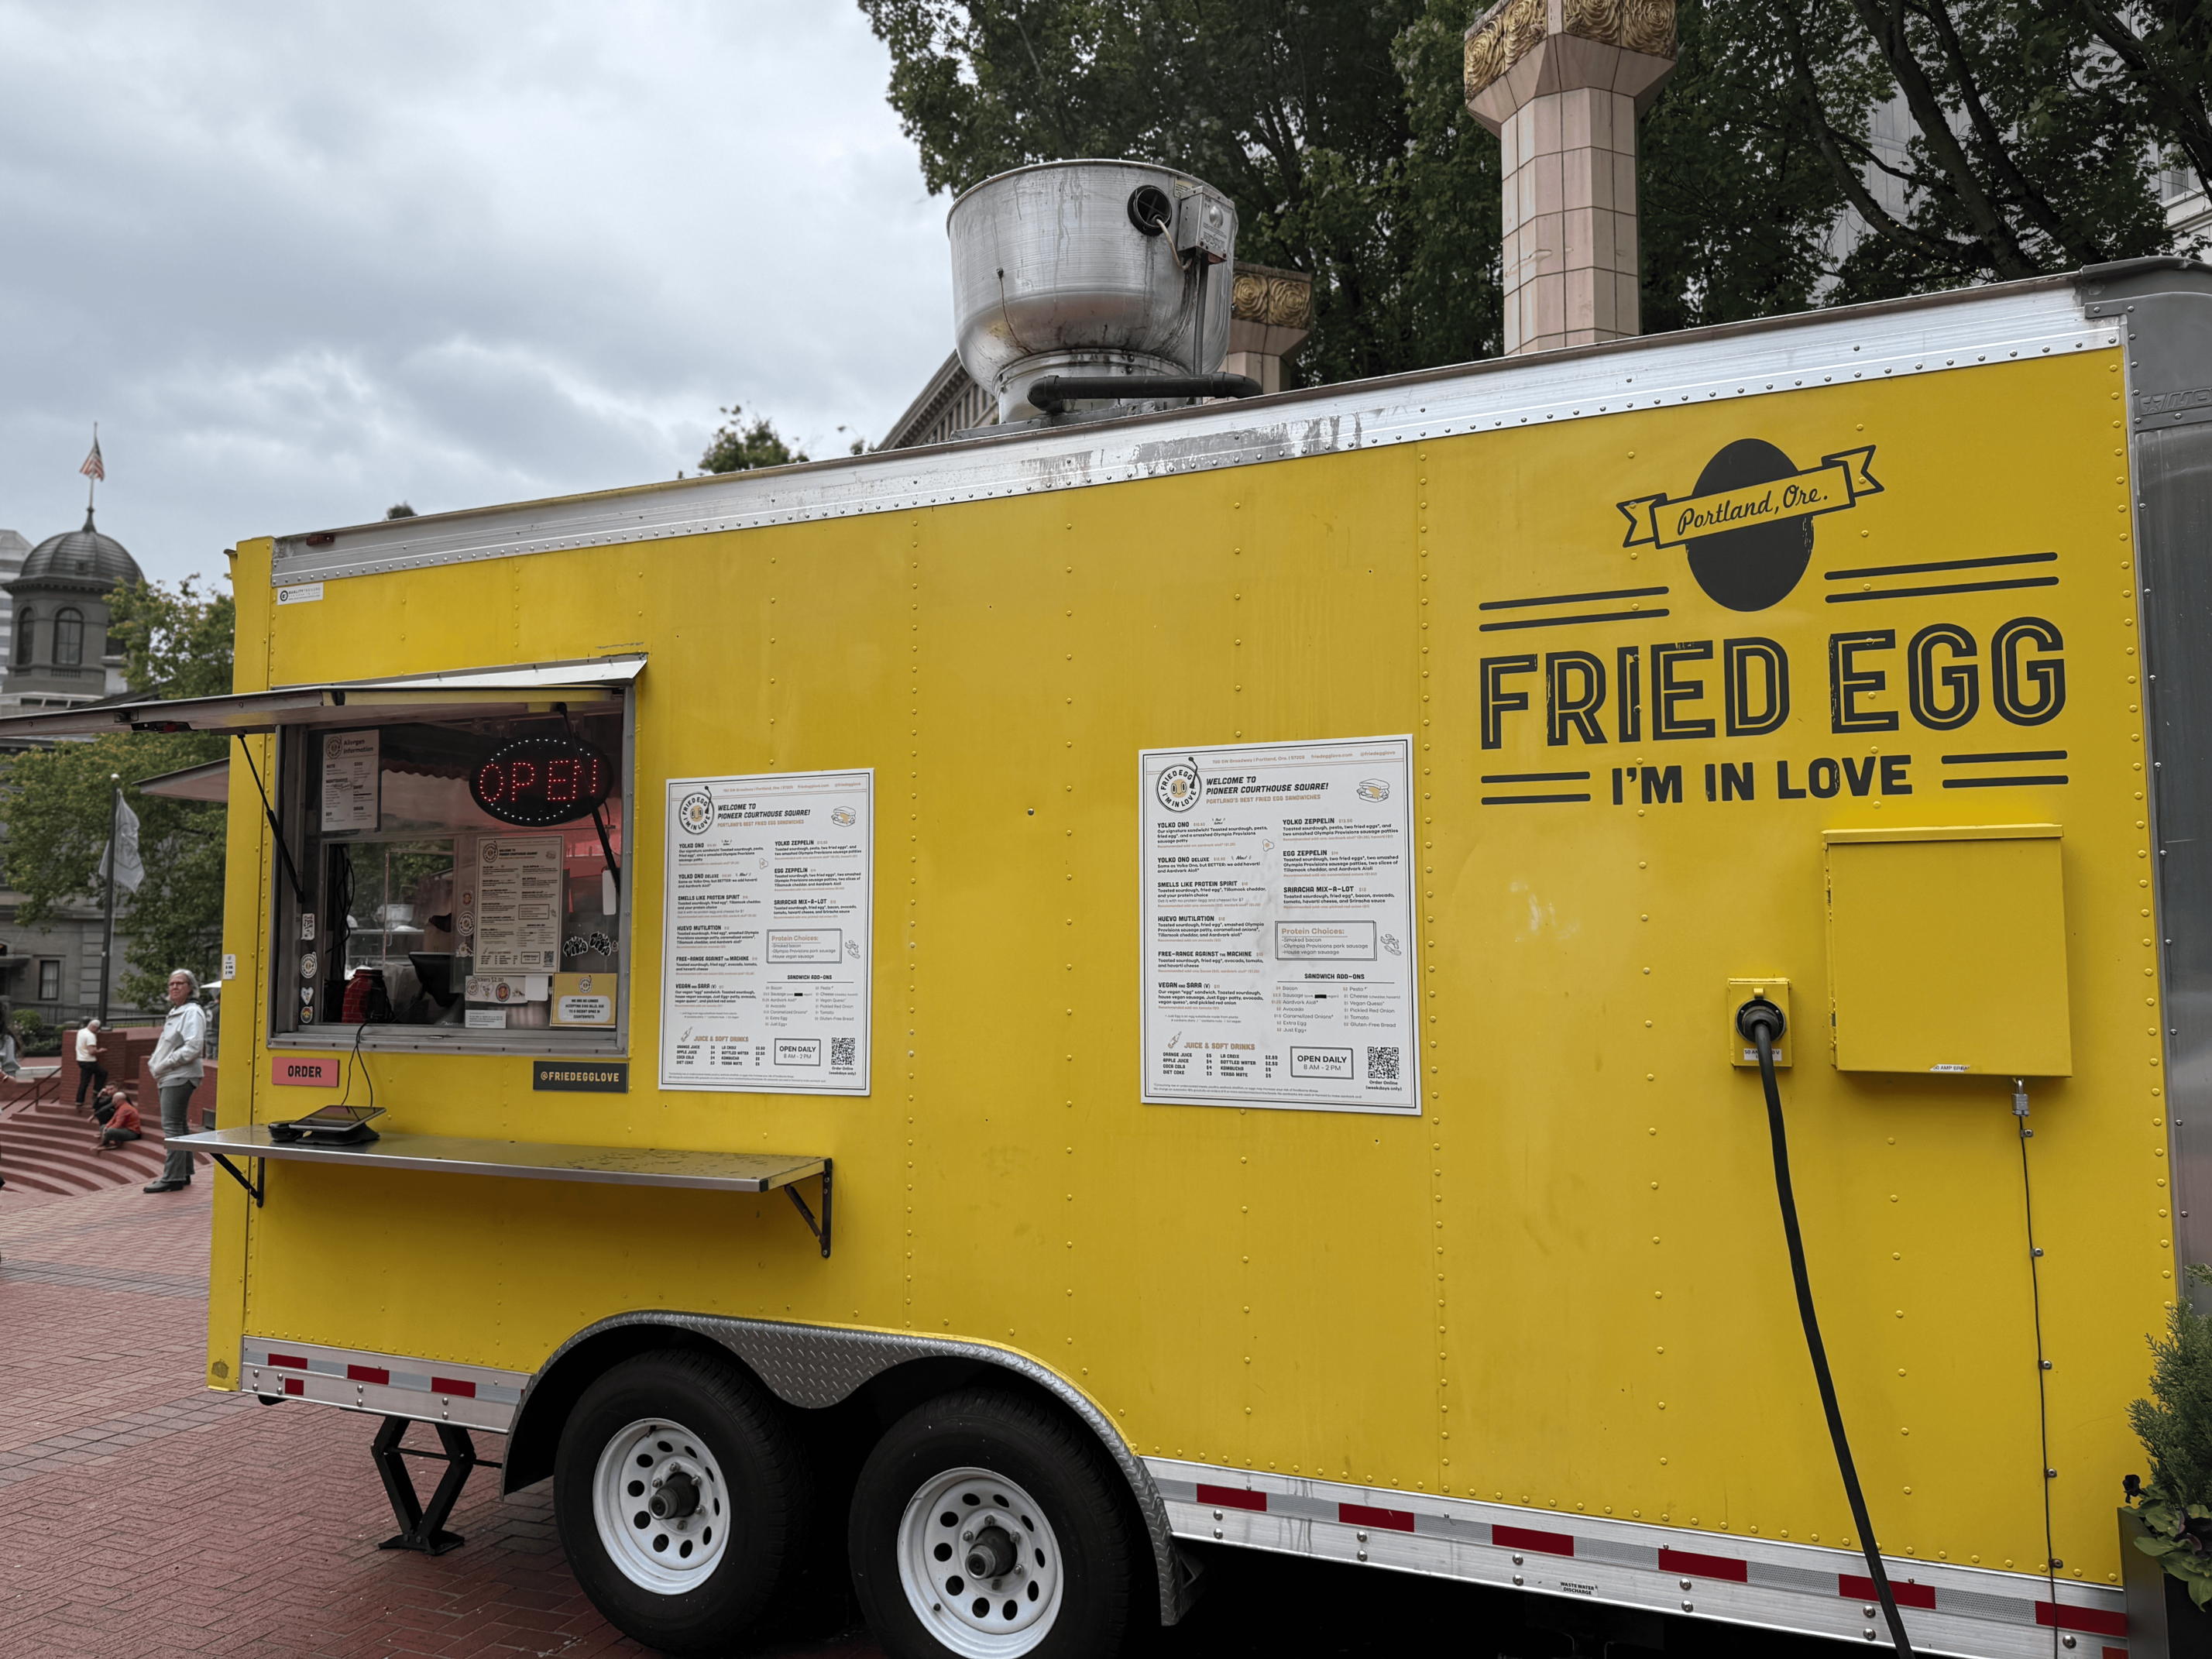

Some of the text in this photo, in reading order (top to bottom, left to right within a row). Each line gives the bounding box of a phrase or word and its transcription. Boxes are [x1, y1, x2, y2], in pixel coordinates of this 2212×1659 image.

[1677, 484, 1829, 536] Portland, Ore.
[1480, 617, 2066, 751] FRIED EGG
[479, 759, 597, 802] OPEN
[1161, 769, 1193, 790] FRIED EGG
[1206, 777, 1244, 785] WELCOME
[1241, 784, 1292, 793] COURTHOUSE
[1294, 783, 1329, 791] SQUARE!
[1612, 754, 1913, 806] I'M IN LOVE
[1162, 793, 1172, 804] I'M
[1181, 790, 1196, 807] LOVE
[287, 1065, 321, 1078] ORDER
[540, 1071, 619, 1082] @FRIEDEGGLOVE
